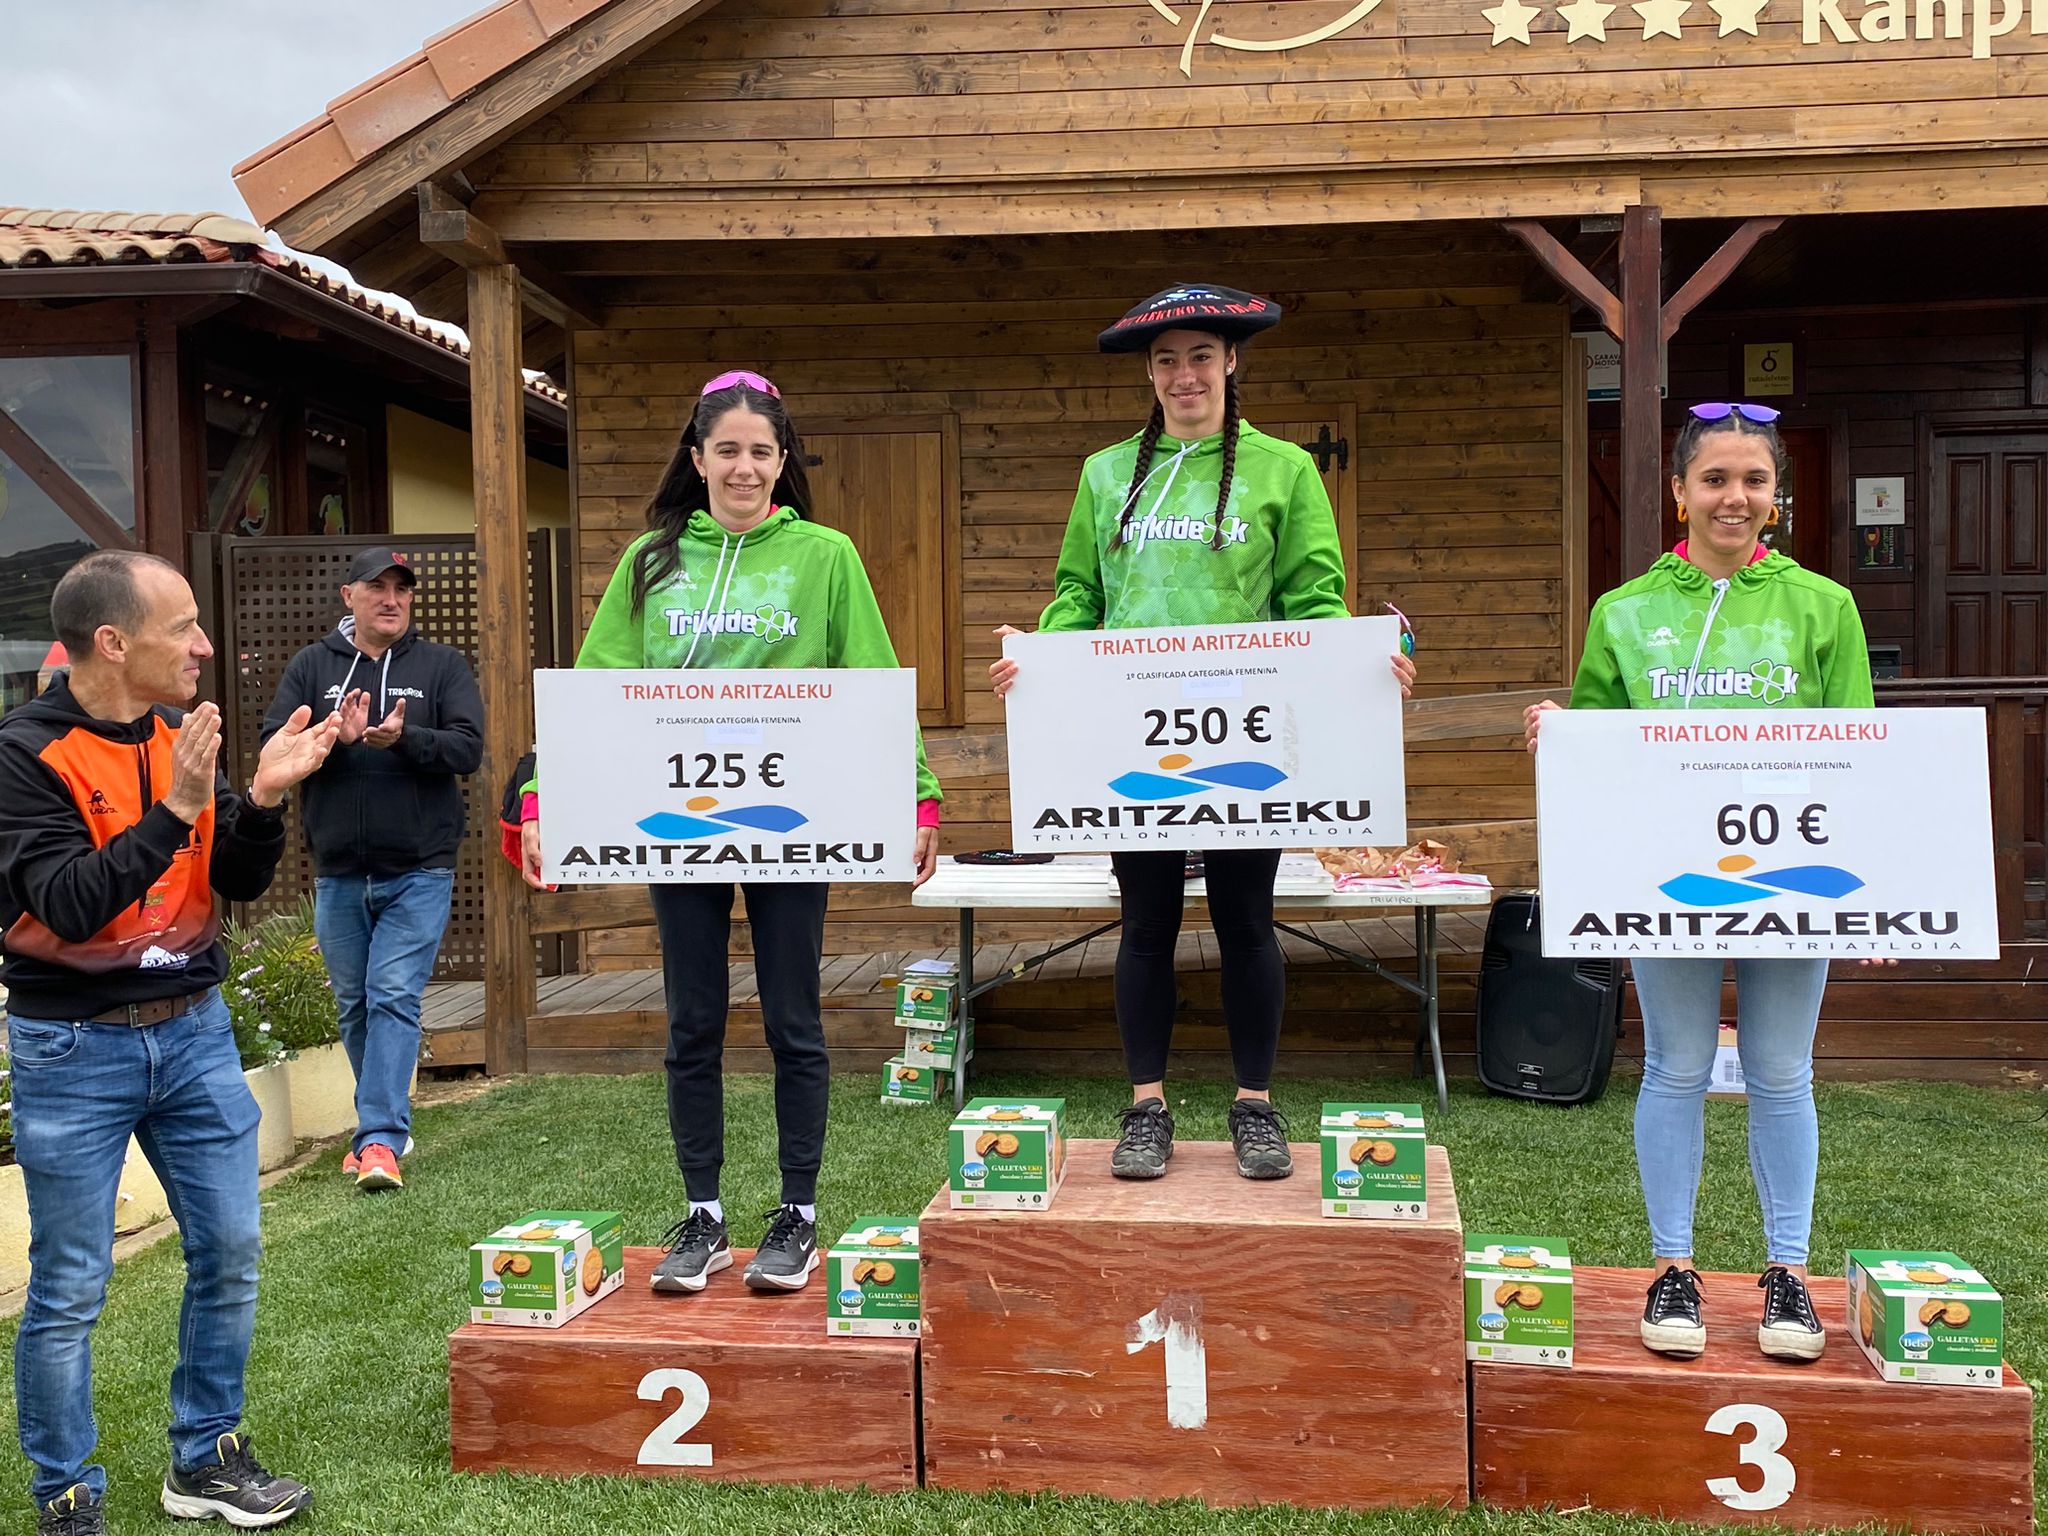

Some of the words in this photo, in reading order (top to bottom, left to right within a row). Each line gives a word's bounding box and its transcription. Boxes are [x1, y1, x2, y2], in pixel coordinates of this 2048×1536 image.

[1090, 636, 1186, 656] TRIATLON
[1191, 630, 1311, 652] ARITZALEKU
[1136, 670, 1187, 680] CLASIFICADA
[1188, 667, 1234, 678] CATEGORÍA
[1235, 666, 1279, 676] FEMENINA
[621, 684, 714, 700] TRIATLON
[720, 683, 832, 700] ARITZALEKU
[666, 717, 715, 725] CLASIFICADA
[715, 716, 760, 725] CATEGORÍA
[760, 716, 802, 724] FEMENINA
[1144, 706, 1229, 747] 250
[1242, 704, 1272, 744] €
[1639, 724, 1748, 743] TRIATLON
[1755, 723, 1888, 742] ARITZALEKU
[667, 752, 747, 789] 125
[757, 752, 785, 789] €
[1691, 762, 1750, 771] CLASIFICADA
[1750, 760, 1803, 771] CATEGORÍA
[1804, 761, 1853, 770] FEMENINA
[1032, 800, 1371, 829] ARITZALEKU
[1716, 803, 1780, 846] 60
[1796, 803, 1830, 846] €
[1033, 831, 1168, 842] TRIATLON
[1218, 827, 1373, 838] TRIATLOIA
[559, 842, 884, 867] ARITZALEKU
[560, 869, 694, 878] TRIATLON
[741, 868, 885, 876] TRIATLOIA
[1568, 911, 1959, 937] ARITZALEKU
[1569, 942, 1729, 951] TRIATLON
[1785, 941, 1961, 951] TRIATLOIA
[1511, 1317, 1551, 1325] GALLETAS
[1937, 1335, 1979, 1344] GALLETAS
[1126, 1308, 1208, 1430] 1
[636, 1367, 713, 1466] 2
[1704, 1403, 1796, 1511] 3
